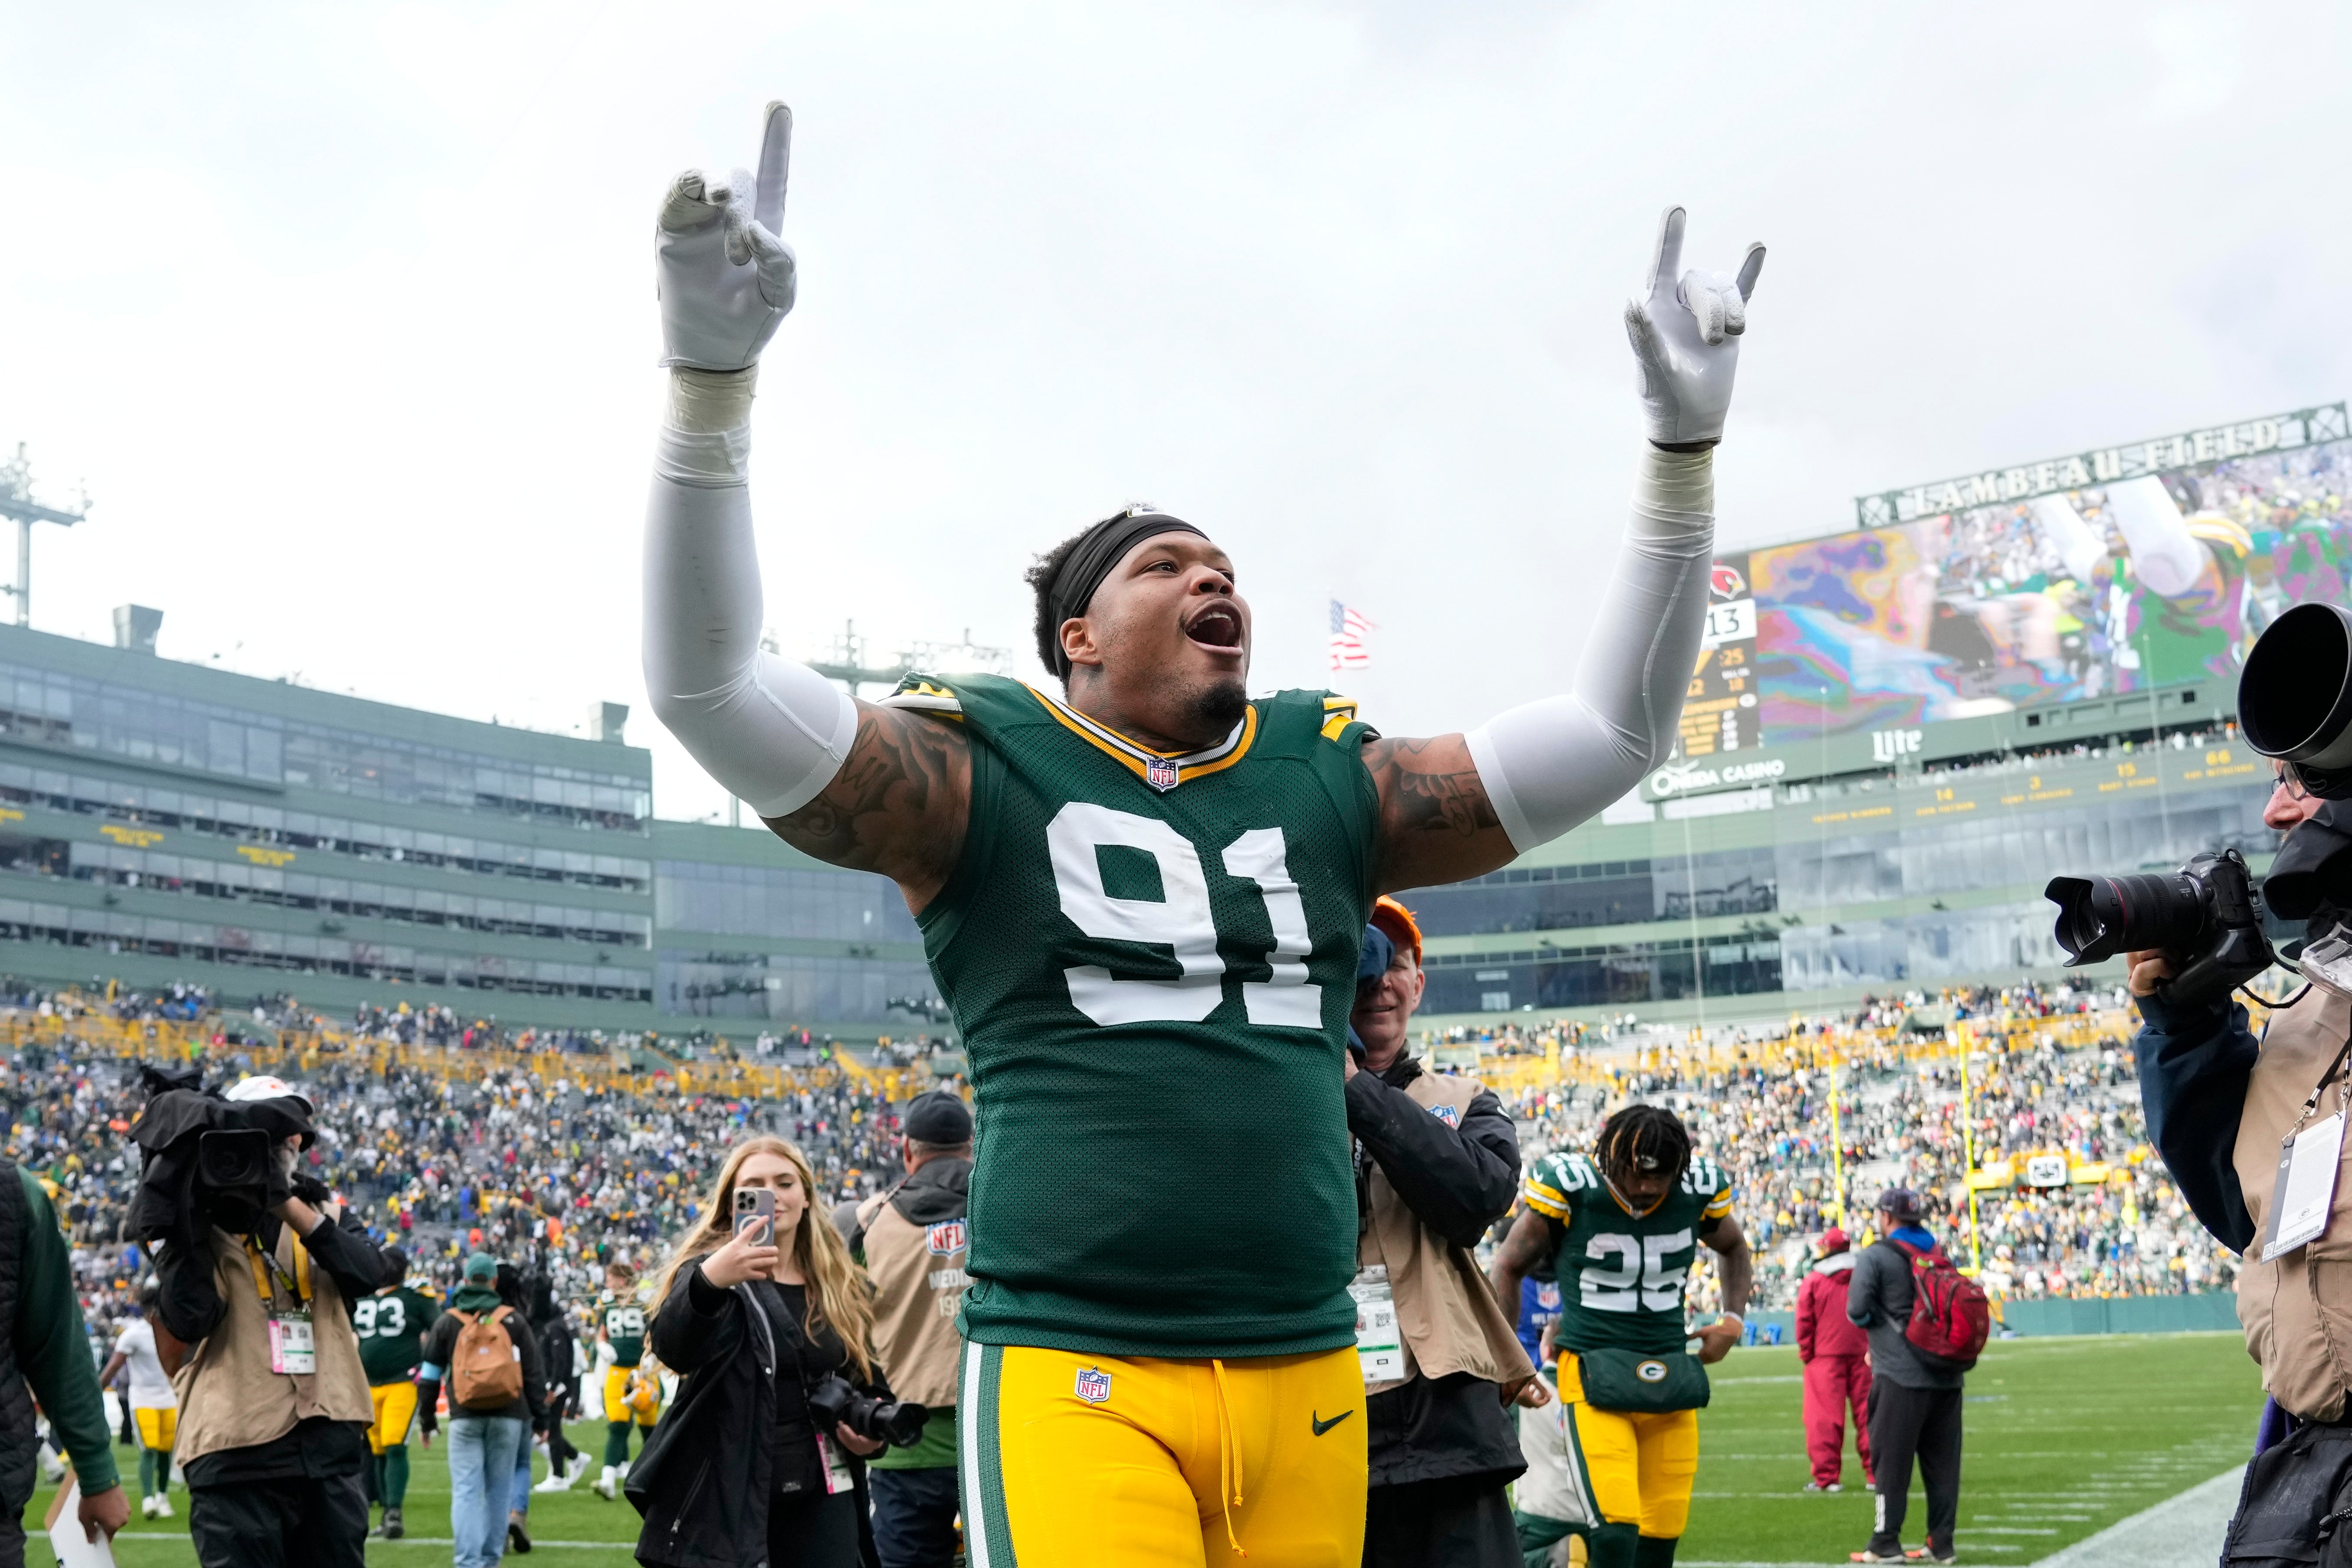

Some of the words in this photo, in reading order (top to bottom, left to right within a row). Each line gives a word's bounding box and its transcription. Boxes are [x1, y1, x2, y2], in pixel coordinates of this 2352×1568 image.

[1912, 448, 2123, 516] LAMBEAU
[2145, 418, 2281, 472] FIELD
[1706, 608, 1739, 636] 13
[1872, 729, 1923, 763] Lite
[1152, 769, 1174, 785] NFL
[1722, 759, 1786, 783] CASINO
[1046, 801, 1324, 1029] 91
[932, 1225, 964, 1249] NFL
[1579, 1227, 1692, 1312] 25
[353, 1297, 407, 1339] 93
[606, 1307, 646, 1338] 89
[1081, 1382, 1104, 1397] NFL
